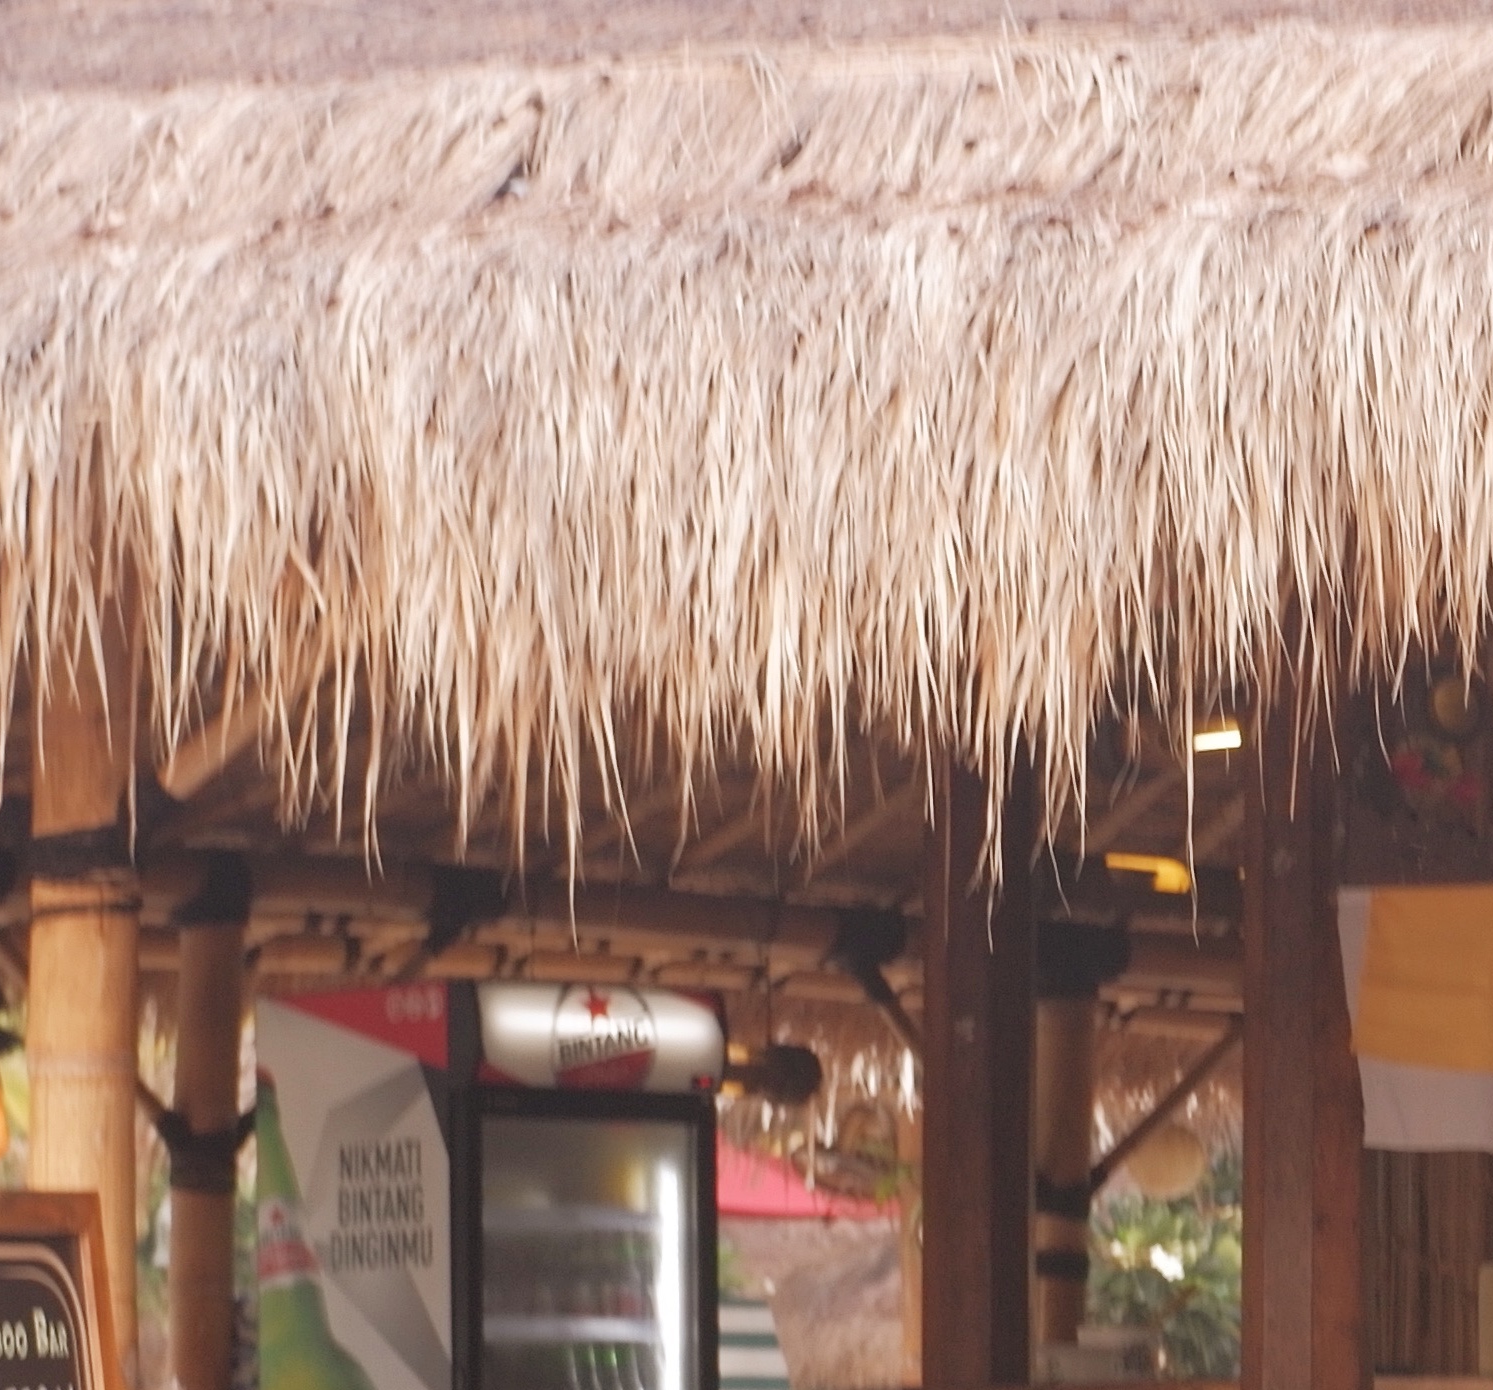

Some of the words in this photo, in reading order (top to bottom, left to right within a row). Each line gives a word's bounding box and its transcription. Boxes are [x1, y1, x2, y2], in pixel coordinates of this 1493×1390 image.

[340, 1138, 422, 1182] NIKMATI
[338, 1183, 424, 1228] BINTANG
[331, 1223, 433, 1273] DINGINMU
